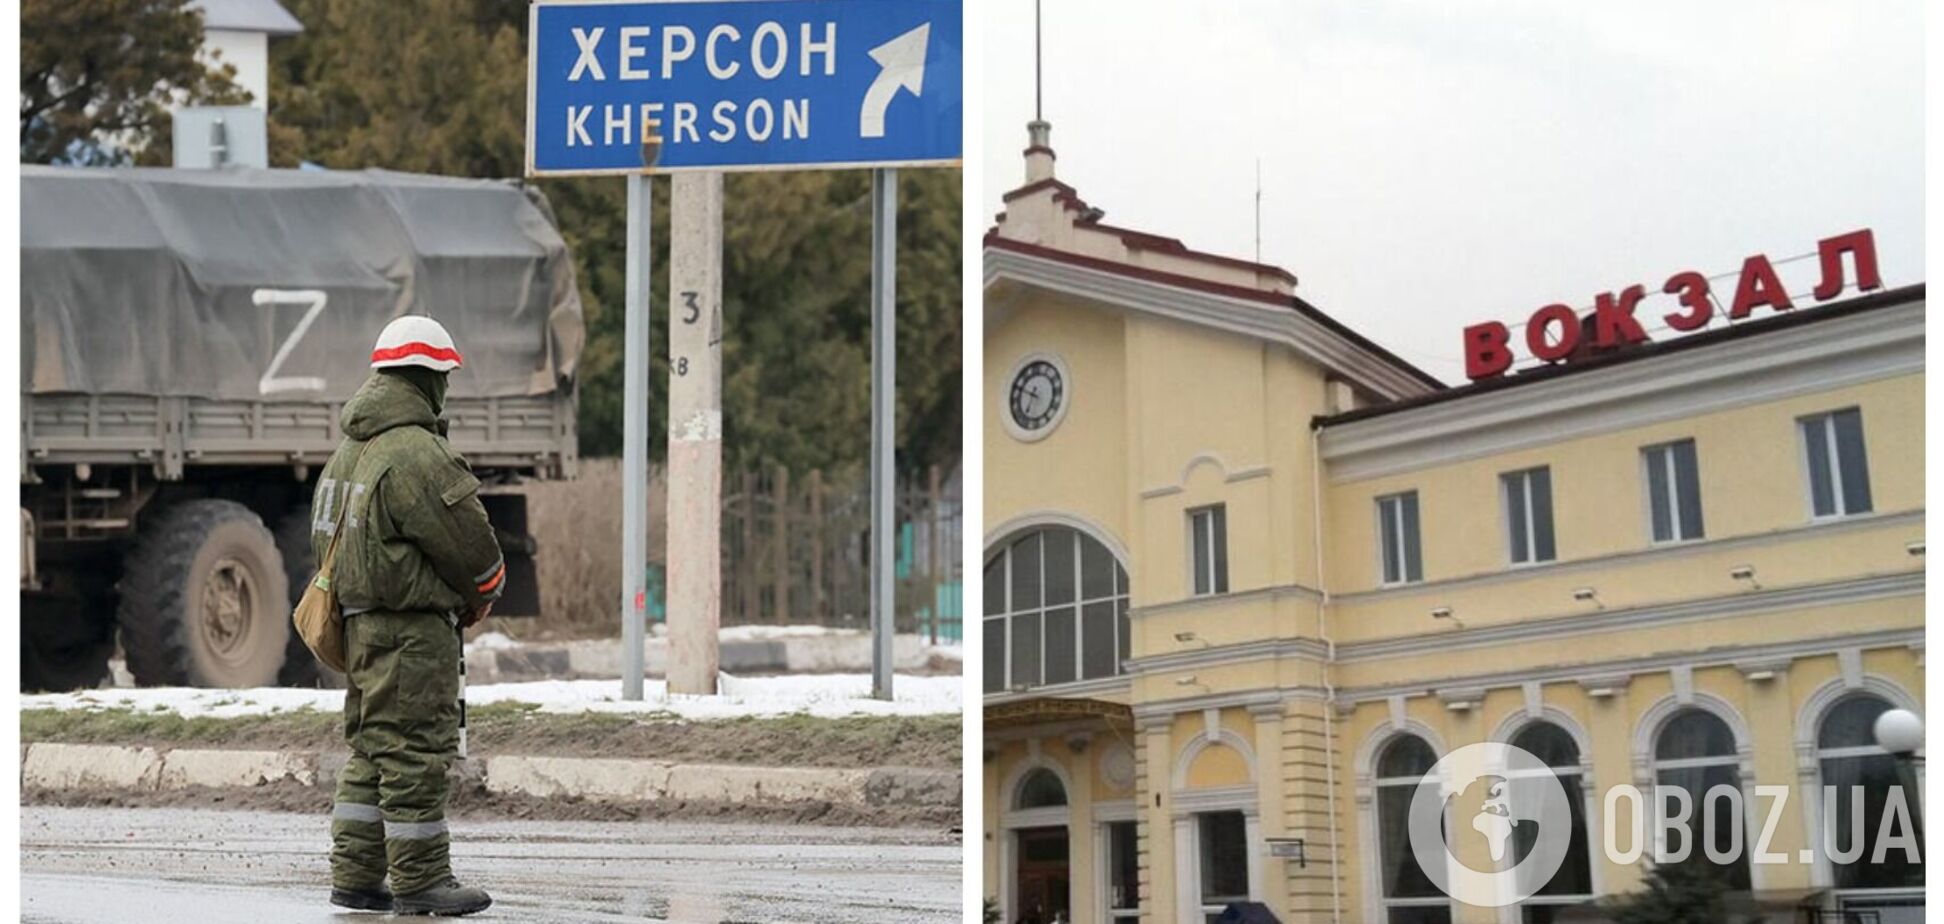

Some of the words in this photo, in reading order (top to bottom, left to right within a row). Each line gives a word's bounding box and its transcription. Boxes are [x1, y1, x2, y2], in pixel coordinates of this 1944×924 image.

[567, 22, 837, 81] ХЕРСОН
[566, 99, 810, 147] KHERSON
[680, 292, 700, 325] 3
[1463, 229, 1882, 381] ВОКЗАЛ
[252, 290, 327, 395] Z
